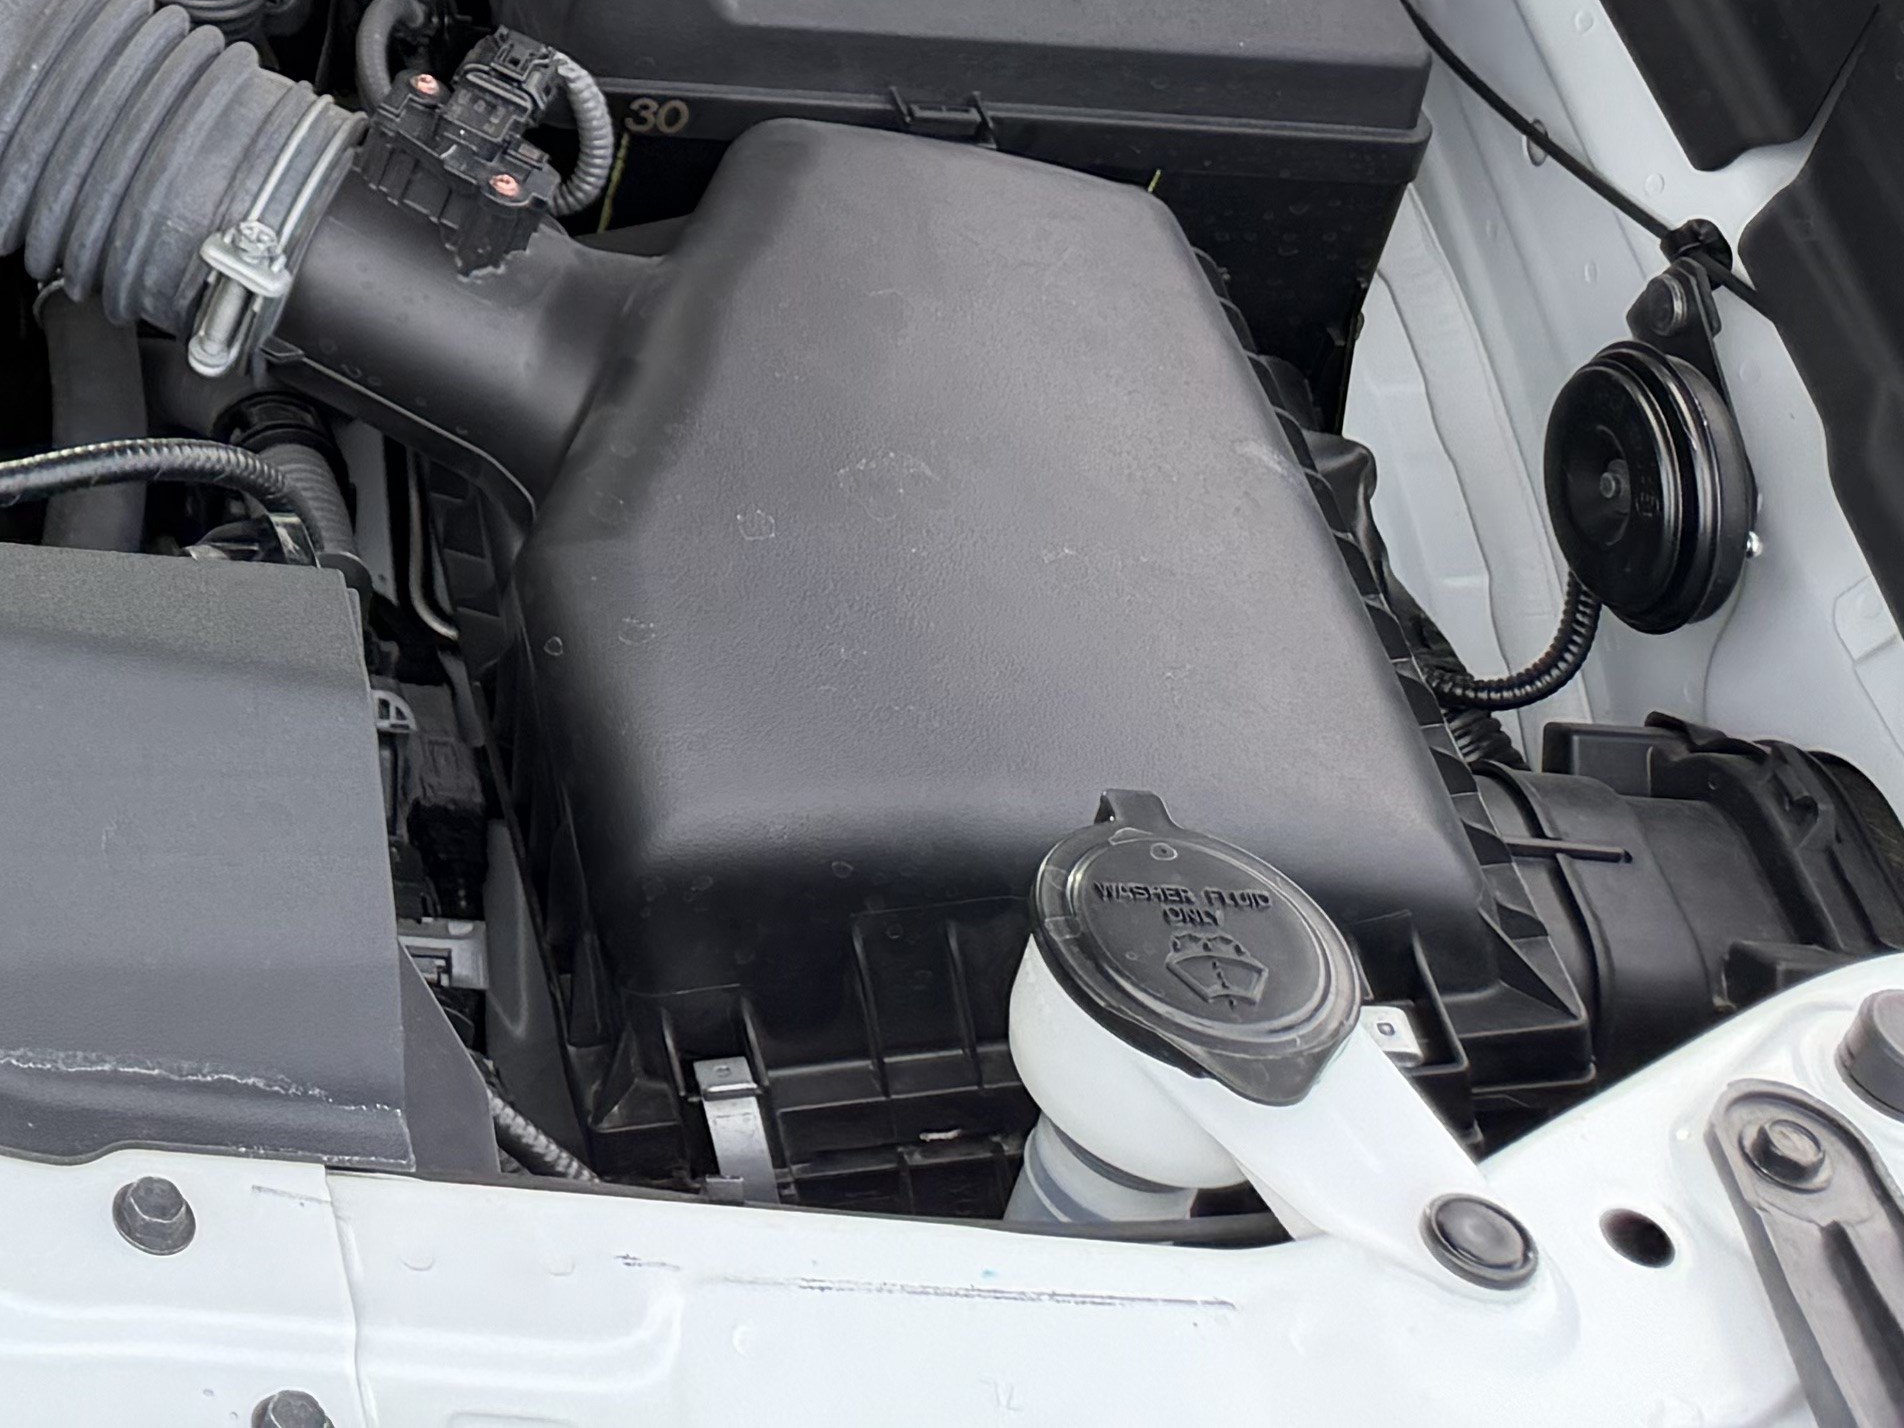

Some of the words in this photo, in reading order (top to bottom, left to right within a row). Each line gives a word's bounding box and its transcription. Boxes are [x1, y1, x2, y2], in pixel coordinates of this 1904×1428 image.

[624, 96, 689, 136] 30
[1092, 880, 1195, 906] WASHER
[1202, 886, 1272, 910] FLUID
[1161, 903, 1222, 927] ONLY
